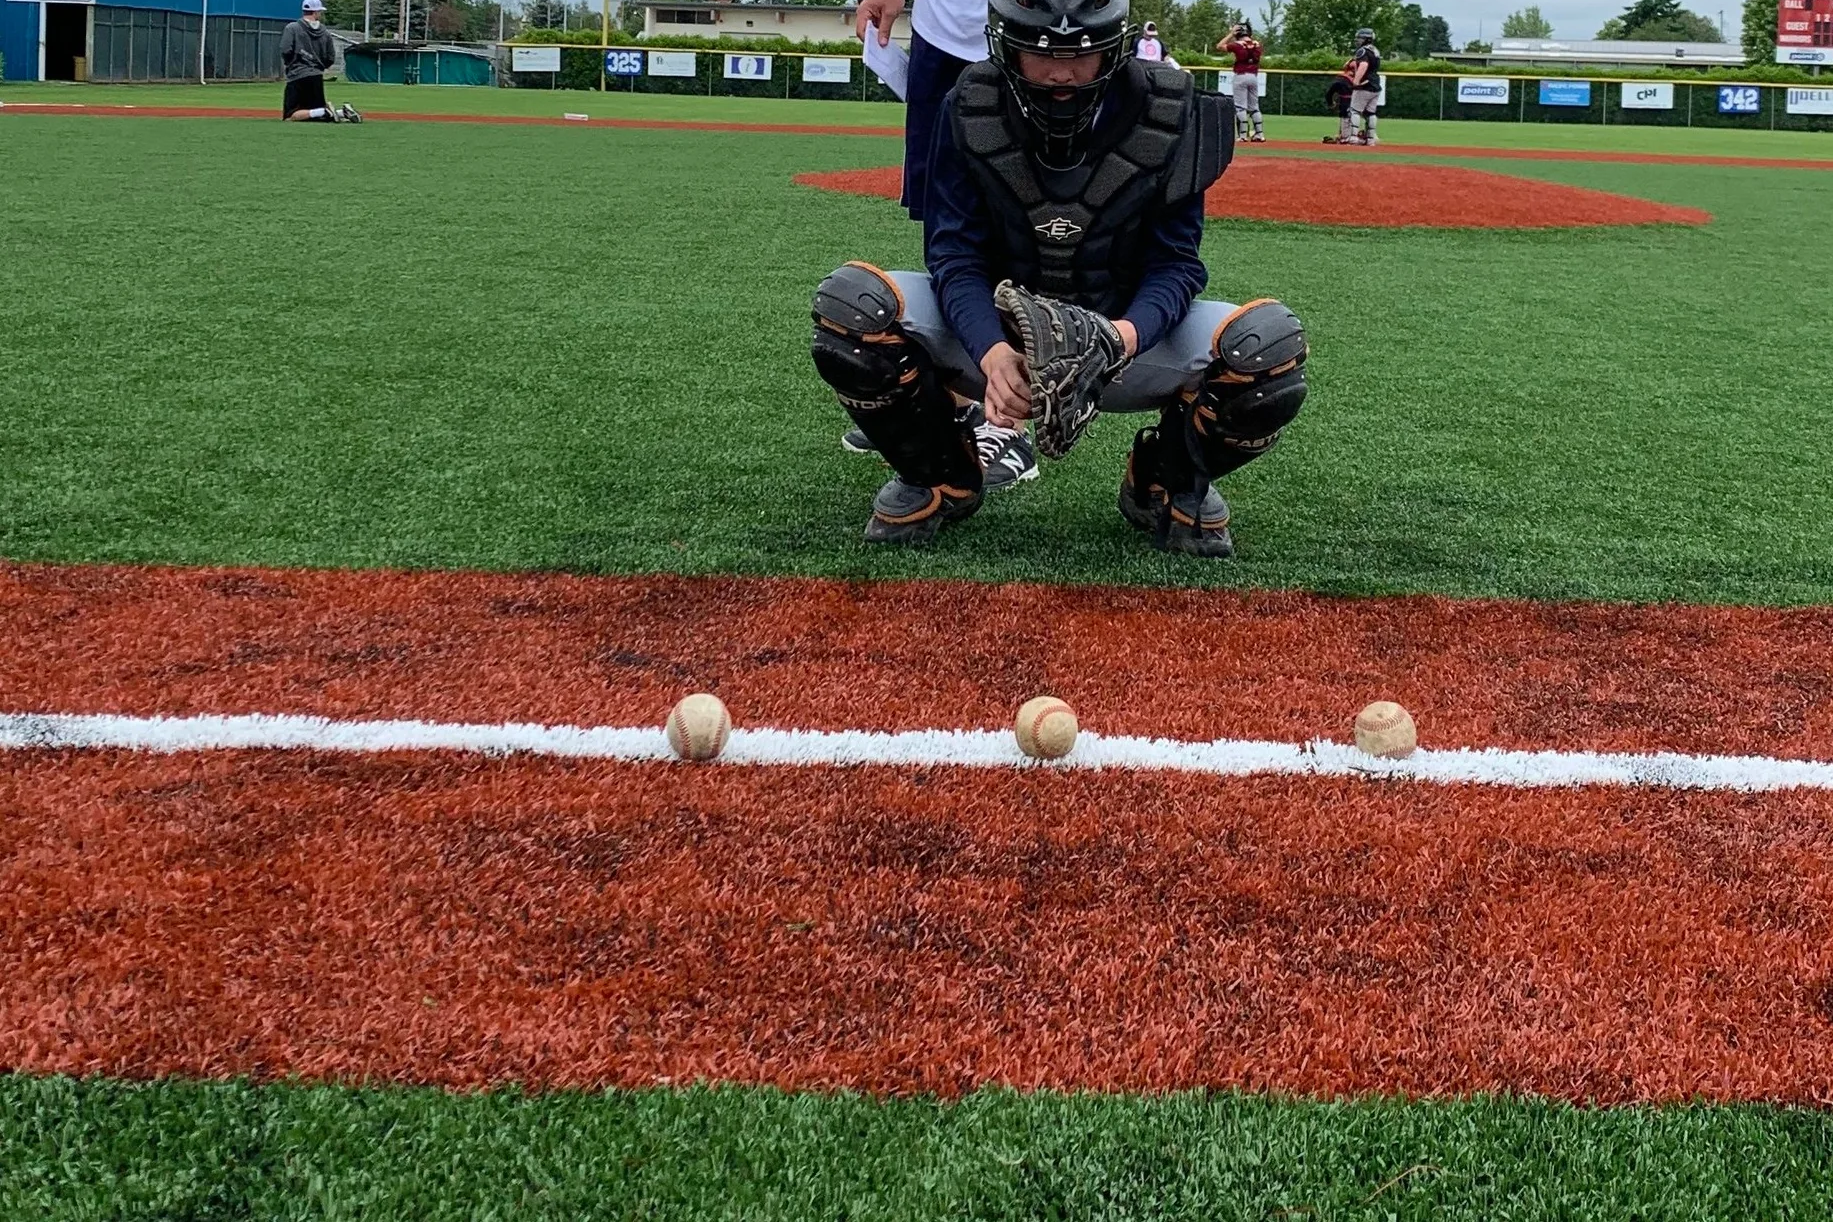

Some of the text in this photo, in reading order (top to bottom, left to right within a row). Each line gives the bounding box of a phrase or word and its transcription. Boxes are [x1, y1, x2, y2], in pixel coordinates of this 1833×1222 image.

[1784, 0, 1804, 9] BALL
[1786, 21, 1809, 31] GUEST
[607, 51, 641, 73] 325
[1463, 86, 1491, 95] point
[1720, 89, 1758, 110] 342
[1051, 223, 1068, 235] E
